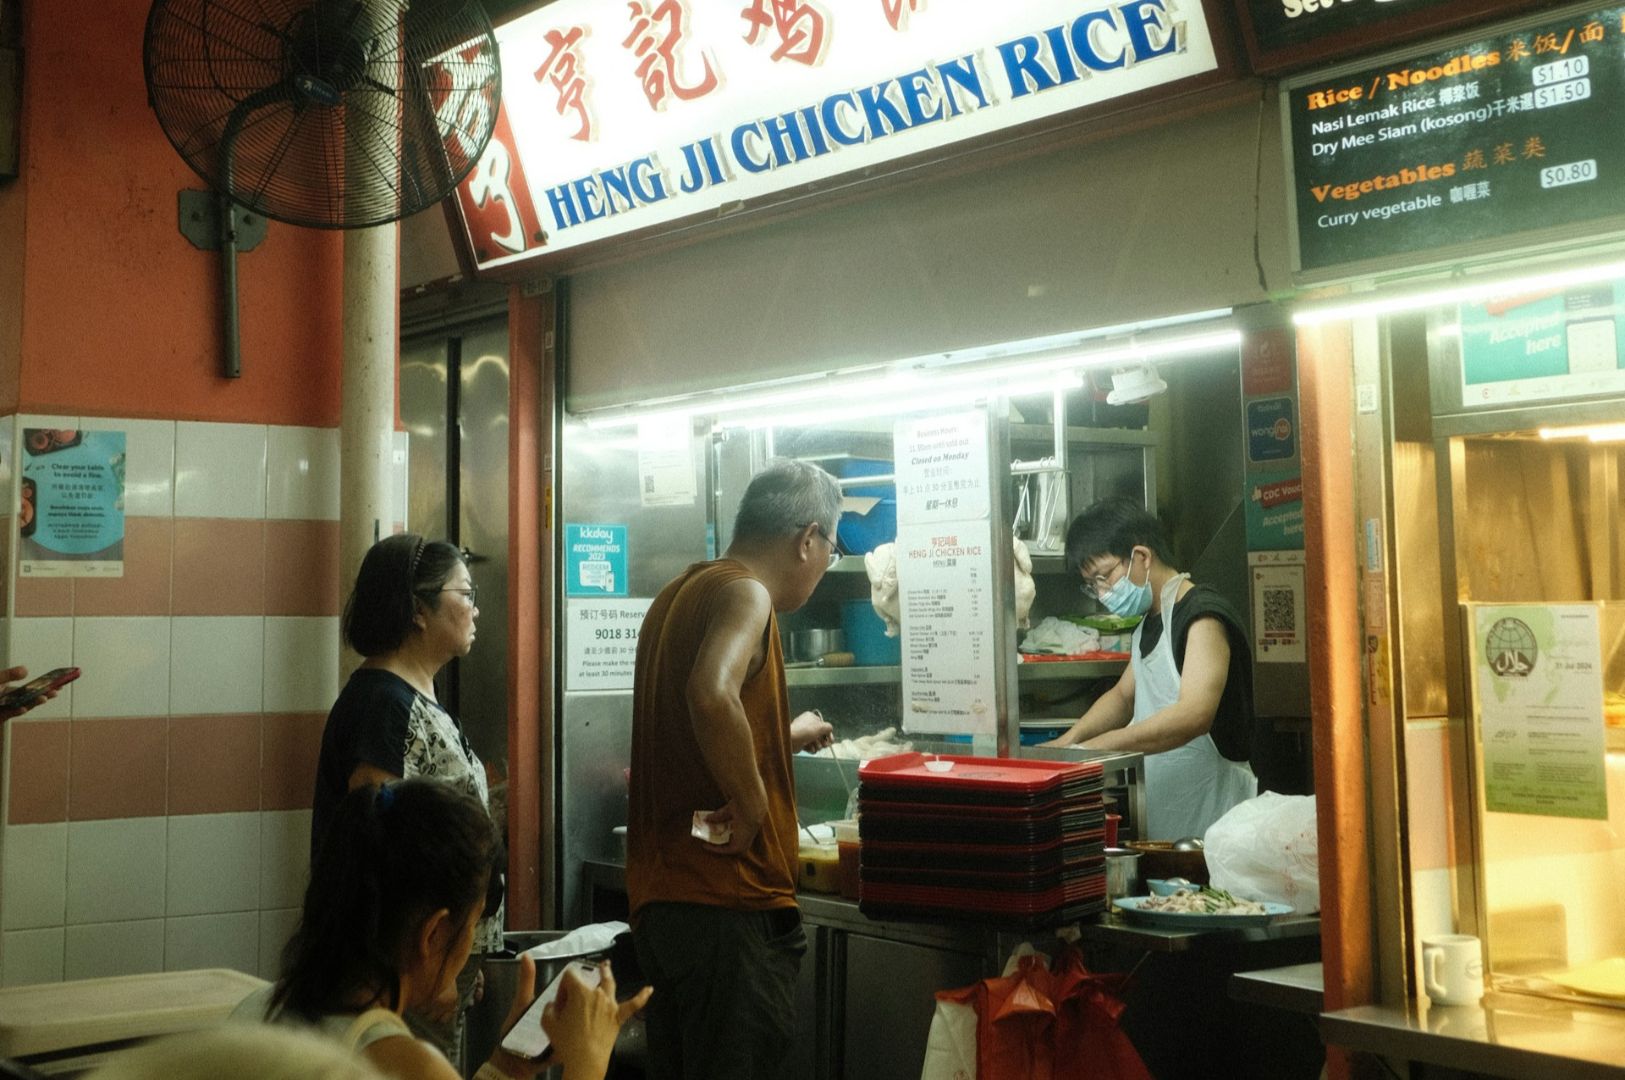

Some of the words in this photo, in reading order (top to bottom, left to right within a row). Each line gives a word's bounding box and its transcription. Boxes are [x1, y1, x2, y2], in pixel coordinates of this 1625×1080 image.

[1307, 86, 1363, 110] Rice
[1368, 76, 1380, 100] /
[1387, 51, 1500, 91] Noodles
[1538, 58, 1583, 83] $1.10
[1539, 81, 1585, 106] $1.50
[544, 156, 671, 231] HENG
[679, 136, 731, 194] JI
[730, 54, 990, 173] CHICKEN
[996, 0, 1179, 99] RICE
[1312, 117, 1344, 135] Nasi
[1347, 104, 1399, 127] Lemak
[1402, 97, 1436, 114] Rice
[1312, 141, 1339, 156] Dry
[1341, 133, 1375, 149] Mee
[1378, 123, 1417, 141] Siam
[1421, 104, 1492, 133] (kosong)
[1311, 162, 1455, 203] Vegetables
[1545, 162, 1592, 185] $0.80
[1317, 212, 1359, 228] Curry
[1362, 194, 1442, 219] vegetable
[1526, 333, 1562, 356] here
[911, 456, 932, 465] Closed
[942, 452, 969, 462] Monday
[1263, 488, 1280, 500] CDC
[580, 527, 613, 544] kkday
[573, 544, 620, 553] RECOMMENDS
[909, 549, 927, 559] HENG
[929, 549, 934, 558] JI
[935, 547, 964, 557] CHICKEN
[966, 546, 982, 556] RICE
[595, 628, 622, 639] 9018
[625, 628, 640, 639] 31
